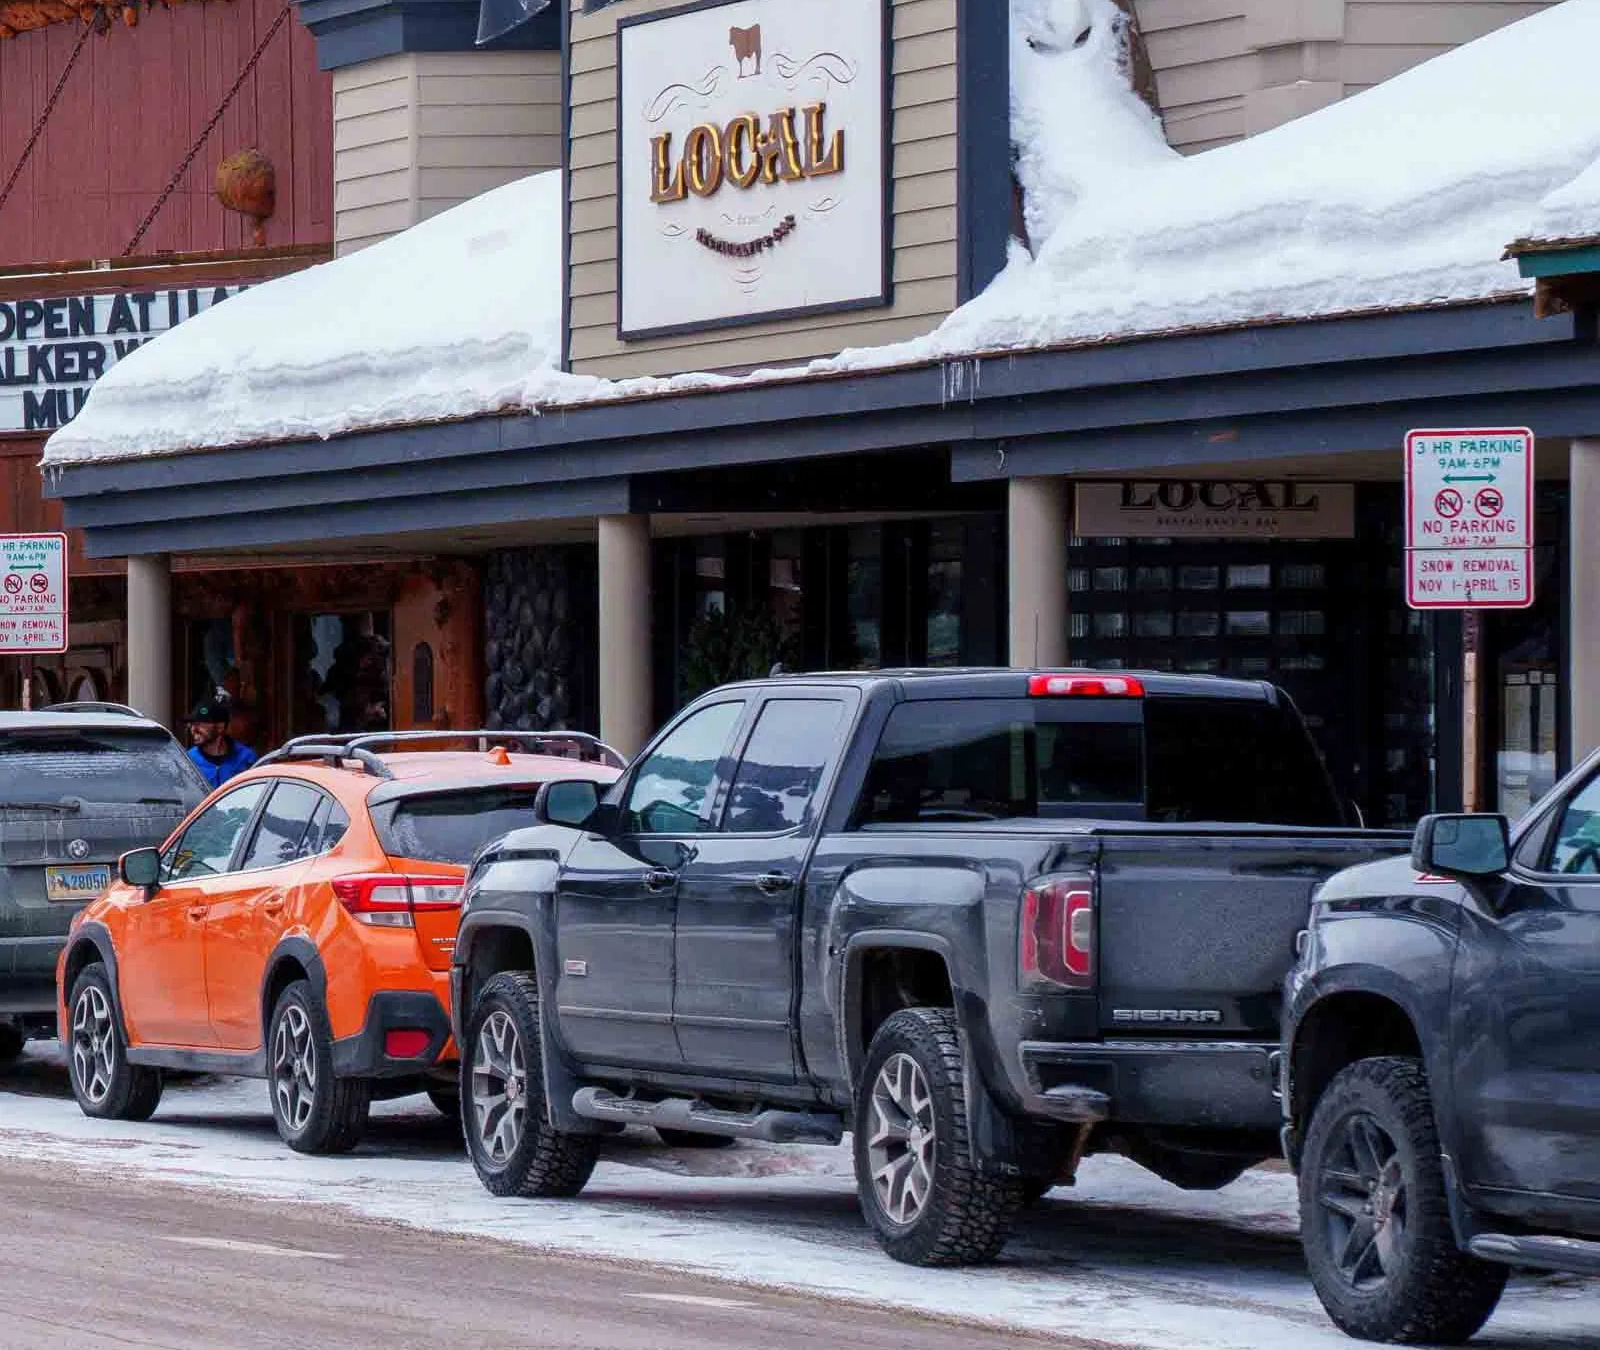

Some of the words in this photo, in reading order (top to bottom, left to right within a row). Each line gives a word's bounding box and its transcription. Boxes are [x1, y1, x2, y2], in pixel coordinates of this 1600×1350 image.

[649, 102, 845, 203] LOCAL
[107, 292, 156, 334] AT
[1416, 442, 1425, 454] 3
[1432, 442, 1453, 454] HR
[1460, 439, 1523, 453] PARKING
[1439, 458, 1500, 469] 9AM-6PM
[1119, 482, 1319, 512] LOCAL
[1423, 521, 1442, 533] NO
[1451, 519, 1516, 533] PARKING
[3, 542, 15, 550] HR
[20, 540, 61, 550] PARKING
[1421, 560, 1453, 572] SNOW
[1463, 559, 1519, 572] REMOVAL
[1419, 580, 1442, 592] NOV
[1507, 578, 1521, 591] 15
[14, 594, 56, 604] PARKING
[22, 620, 58, 629] REMOVAL
[51, 633, 59, 641] 15
[1113, 1009, 1221, 1022] SIERRA
